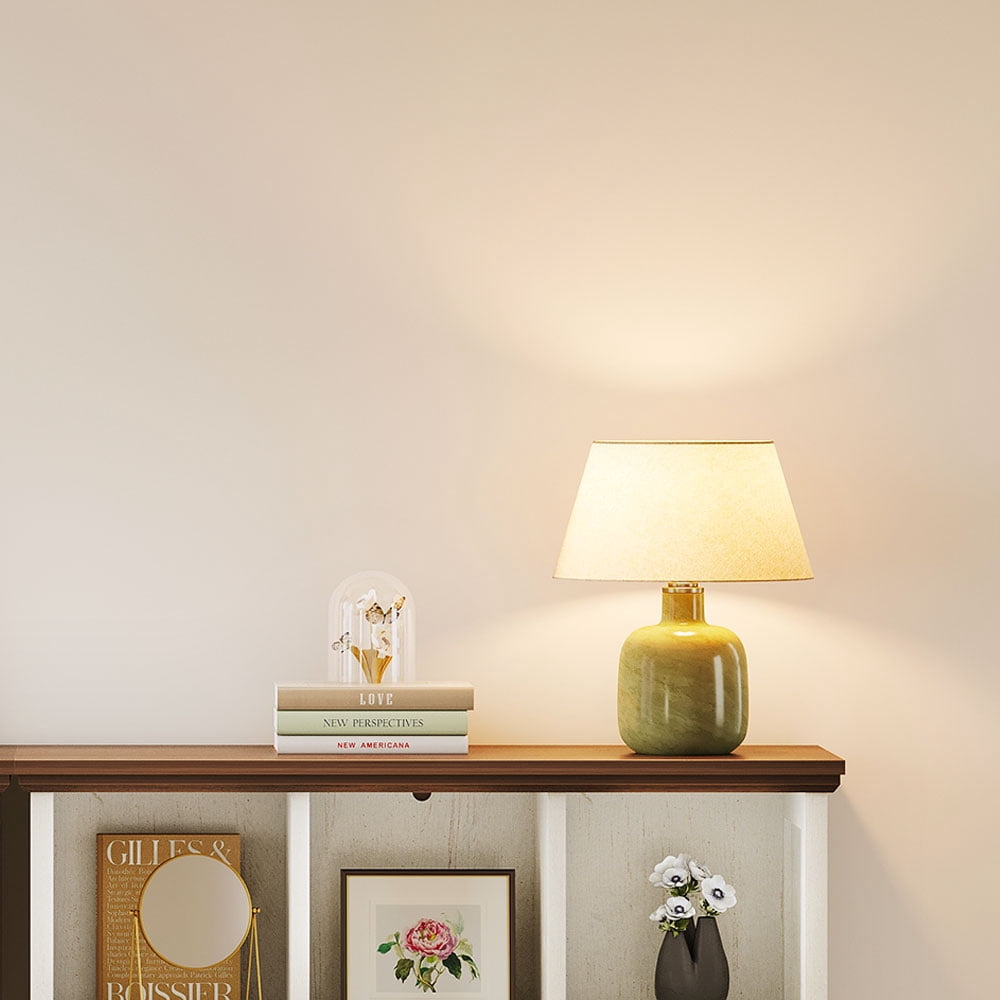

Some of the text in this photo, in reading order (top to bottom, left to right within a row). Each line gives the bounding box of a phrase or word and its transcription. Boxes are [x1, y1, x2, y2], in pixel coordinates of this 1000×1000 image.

[359, 693, 393, 705] LOVE
[323, 718, 424, 728] NEW PERSPECTIVES
